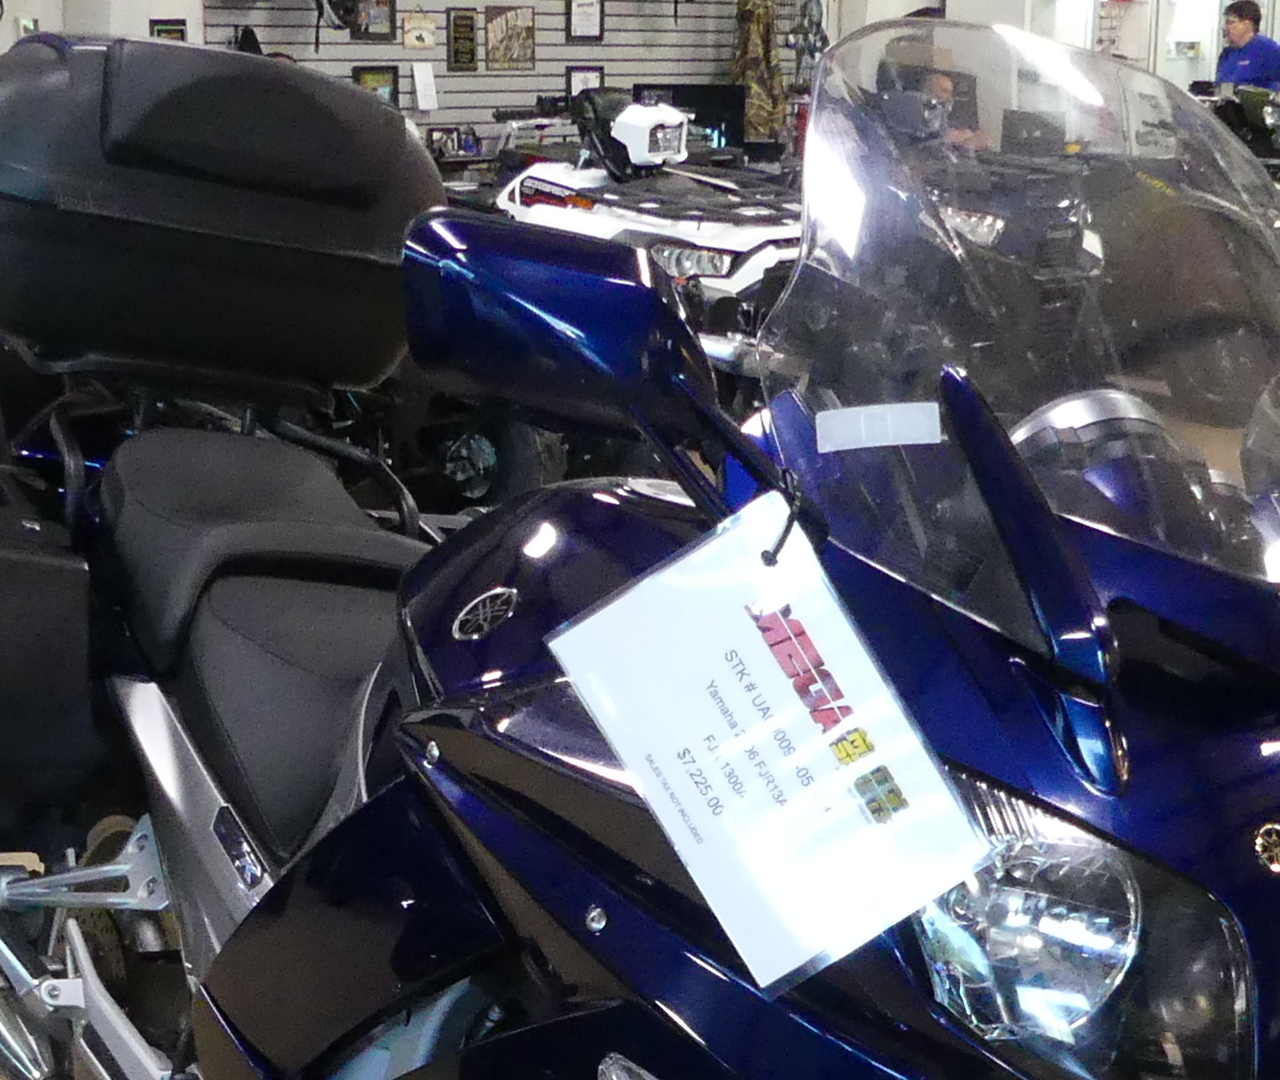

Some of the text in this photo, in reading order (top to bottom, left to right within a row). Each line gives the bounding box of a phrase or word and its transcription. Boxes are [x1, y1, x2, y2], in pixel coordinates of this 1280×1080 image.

[705, 680, 789, 809] Yamaha 26 FJR13A
[724, 649, 814, 788] STK # UA009-05
[645, 753, 703, 845] SALES TAX NOT INCLUDED
[677, 748, 724, 817] $7,225.00
